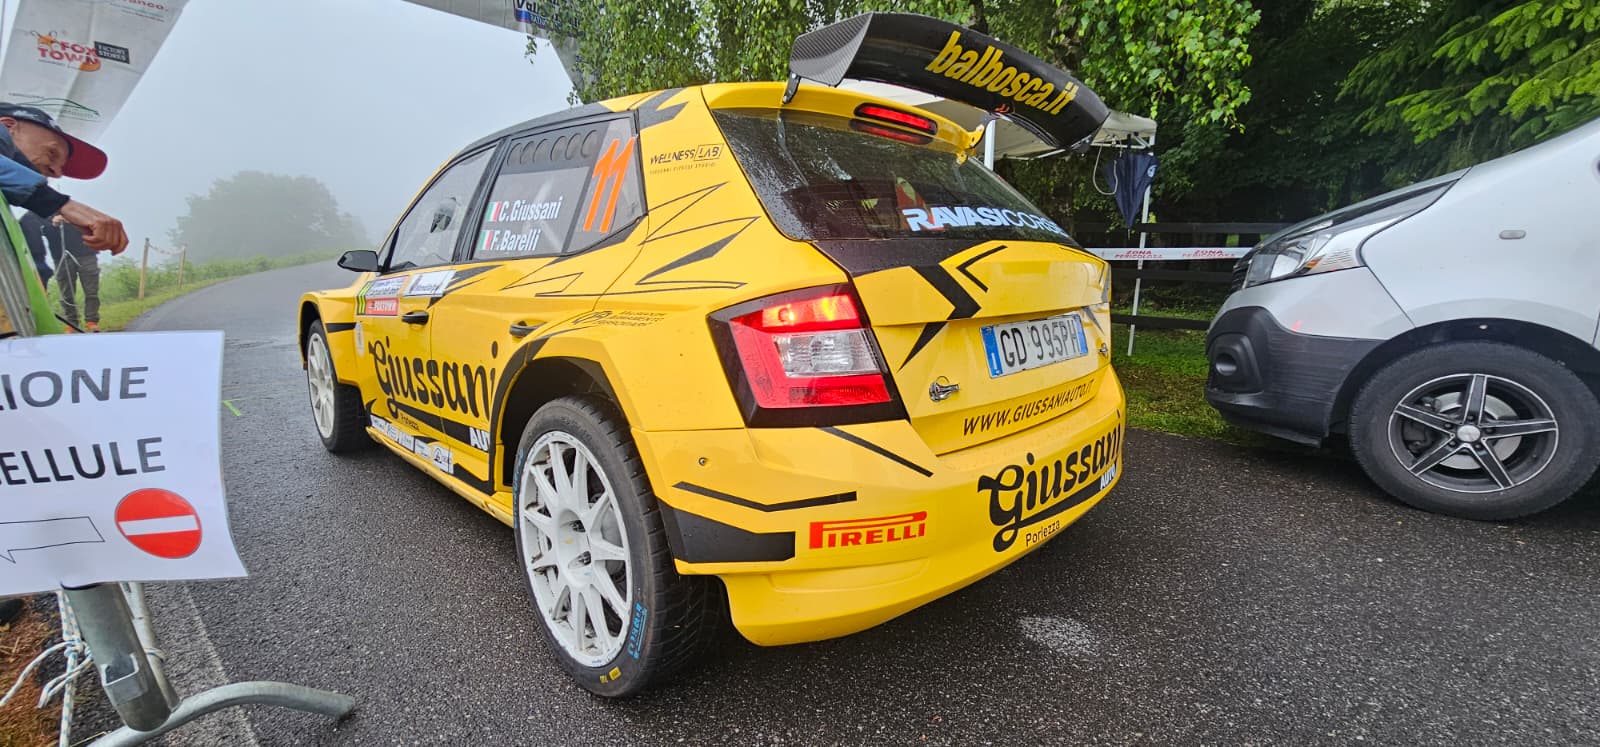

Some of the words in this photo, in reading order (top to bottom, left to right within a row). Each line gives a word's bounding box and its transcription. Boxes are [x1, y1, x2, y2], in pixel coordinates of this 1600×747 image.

[38, 47, 99, 65] TOWN
[60, 41, 98, 57] FOX
[925, 30, 1079, 115] balbosca.it
[650, 149, 696, 165] WELLNESS
[698, 146, 720, 158] LAB
[583, 136, 636, 234] 11
[498, 196, 563, 222] C.Giussani
[490, 229, 541, 251] F.Barelli
[1000, 327, 1027, 367] GD
[0, 366, 149, 411] IONE
[369, 336, 499, 421] Giussani
[963, 379, 1095, 436] WWW.GIUSSANIAUTO.IT
[0, 436, 166, 487] ELLULE
[978, 409, 1121, 553] Giussani
[809, 511, 928, 549] PIRELLI
[1026, 519, 1061, 547] Porlezza
